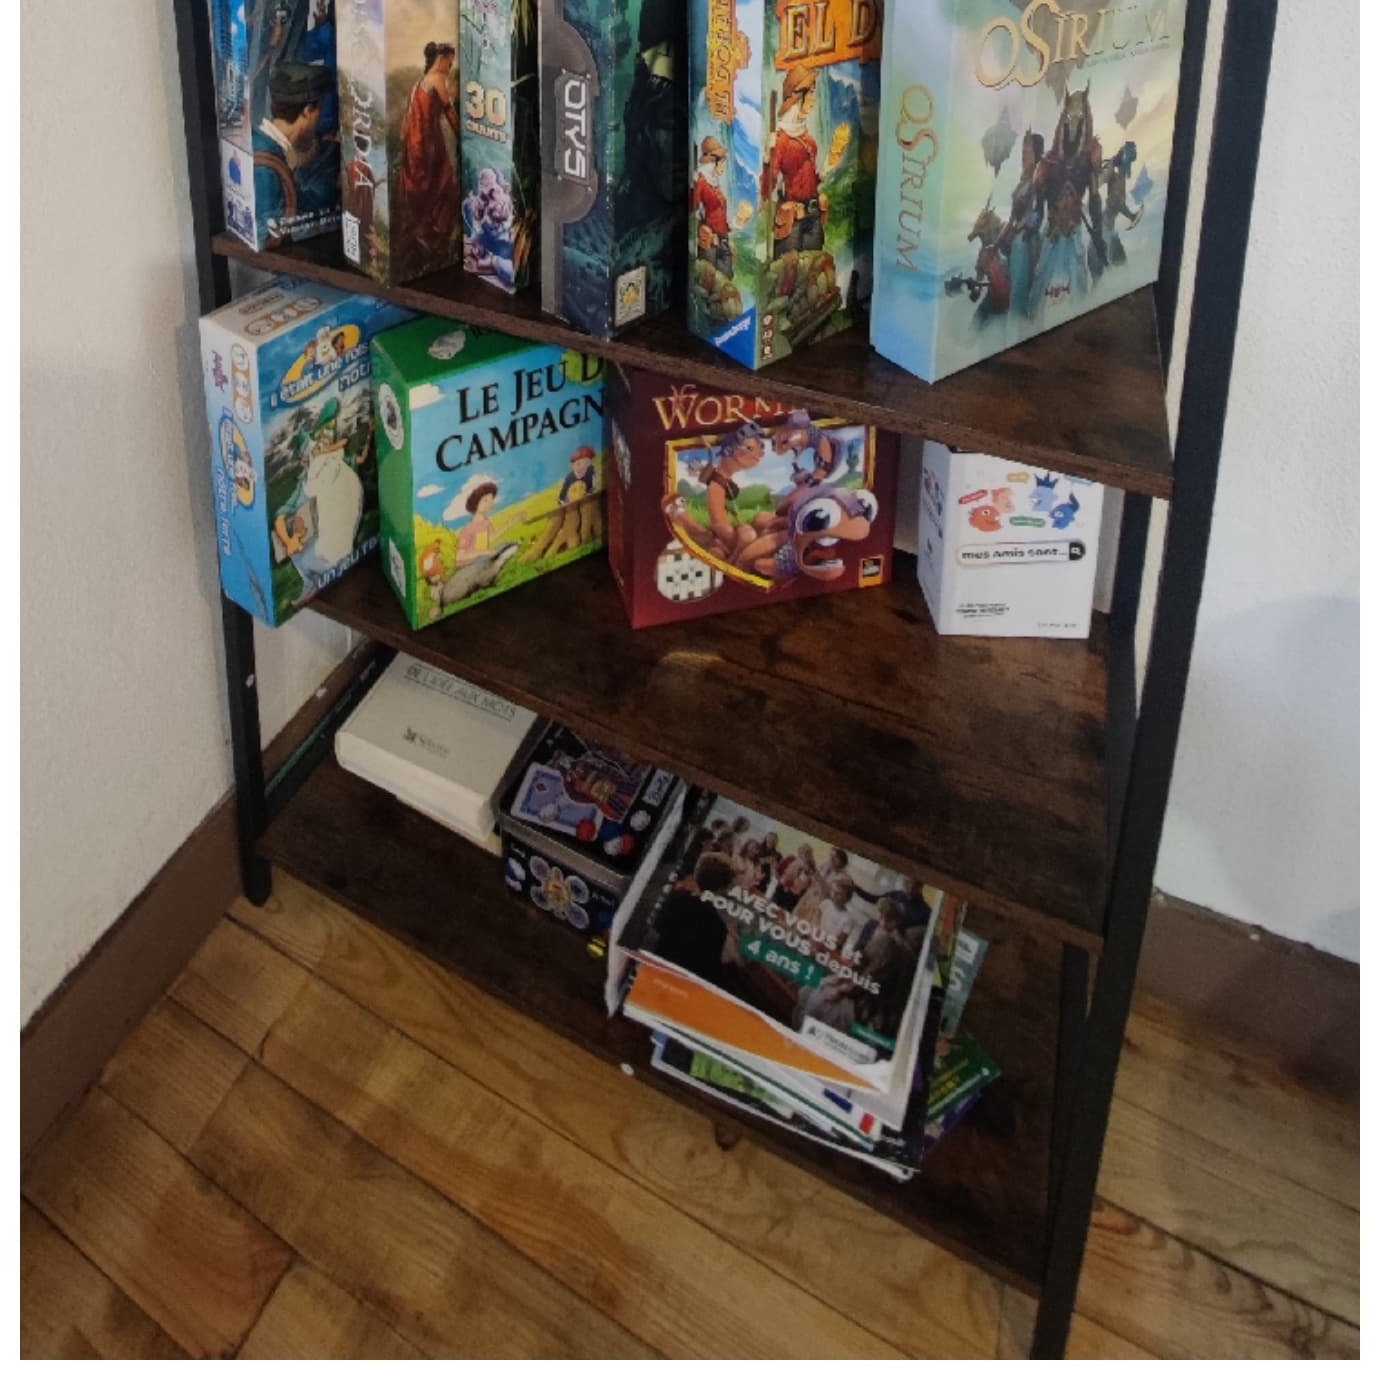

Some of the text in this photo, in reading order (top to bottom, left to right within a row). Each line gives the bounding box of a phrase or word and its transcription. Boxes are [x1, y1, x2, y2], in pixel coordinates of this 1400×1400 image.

[783, 2, 836, 60] EL
[466, 80, 507, 127] 30
[563, 79, 588, 183] OTYS
[458, 383, 499, 425] LE
[511, 360, 567, 414] JEU
[701, 889, 882, 995] POUR VOUS depuis
[728, 885, 779, 919] AVEC
[784, 911, 838, 950] VOUS
[747, 939, 762, 956] 4
[765, 950, 801, 974] ans
